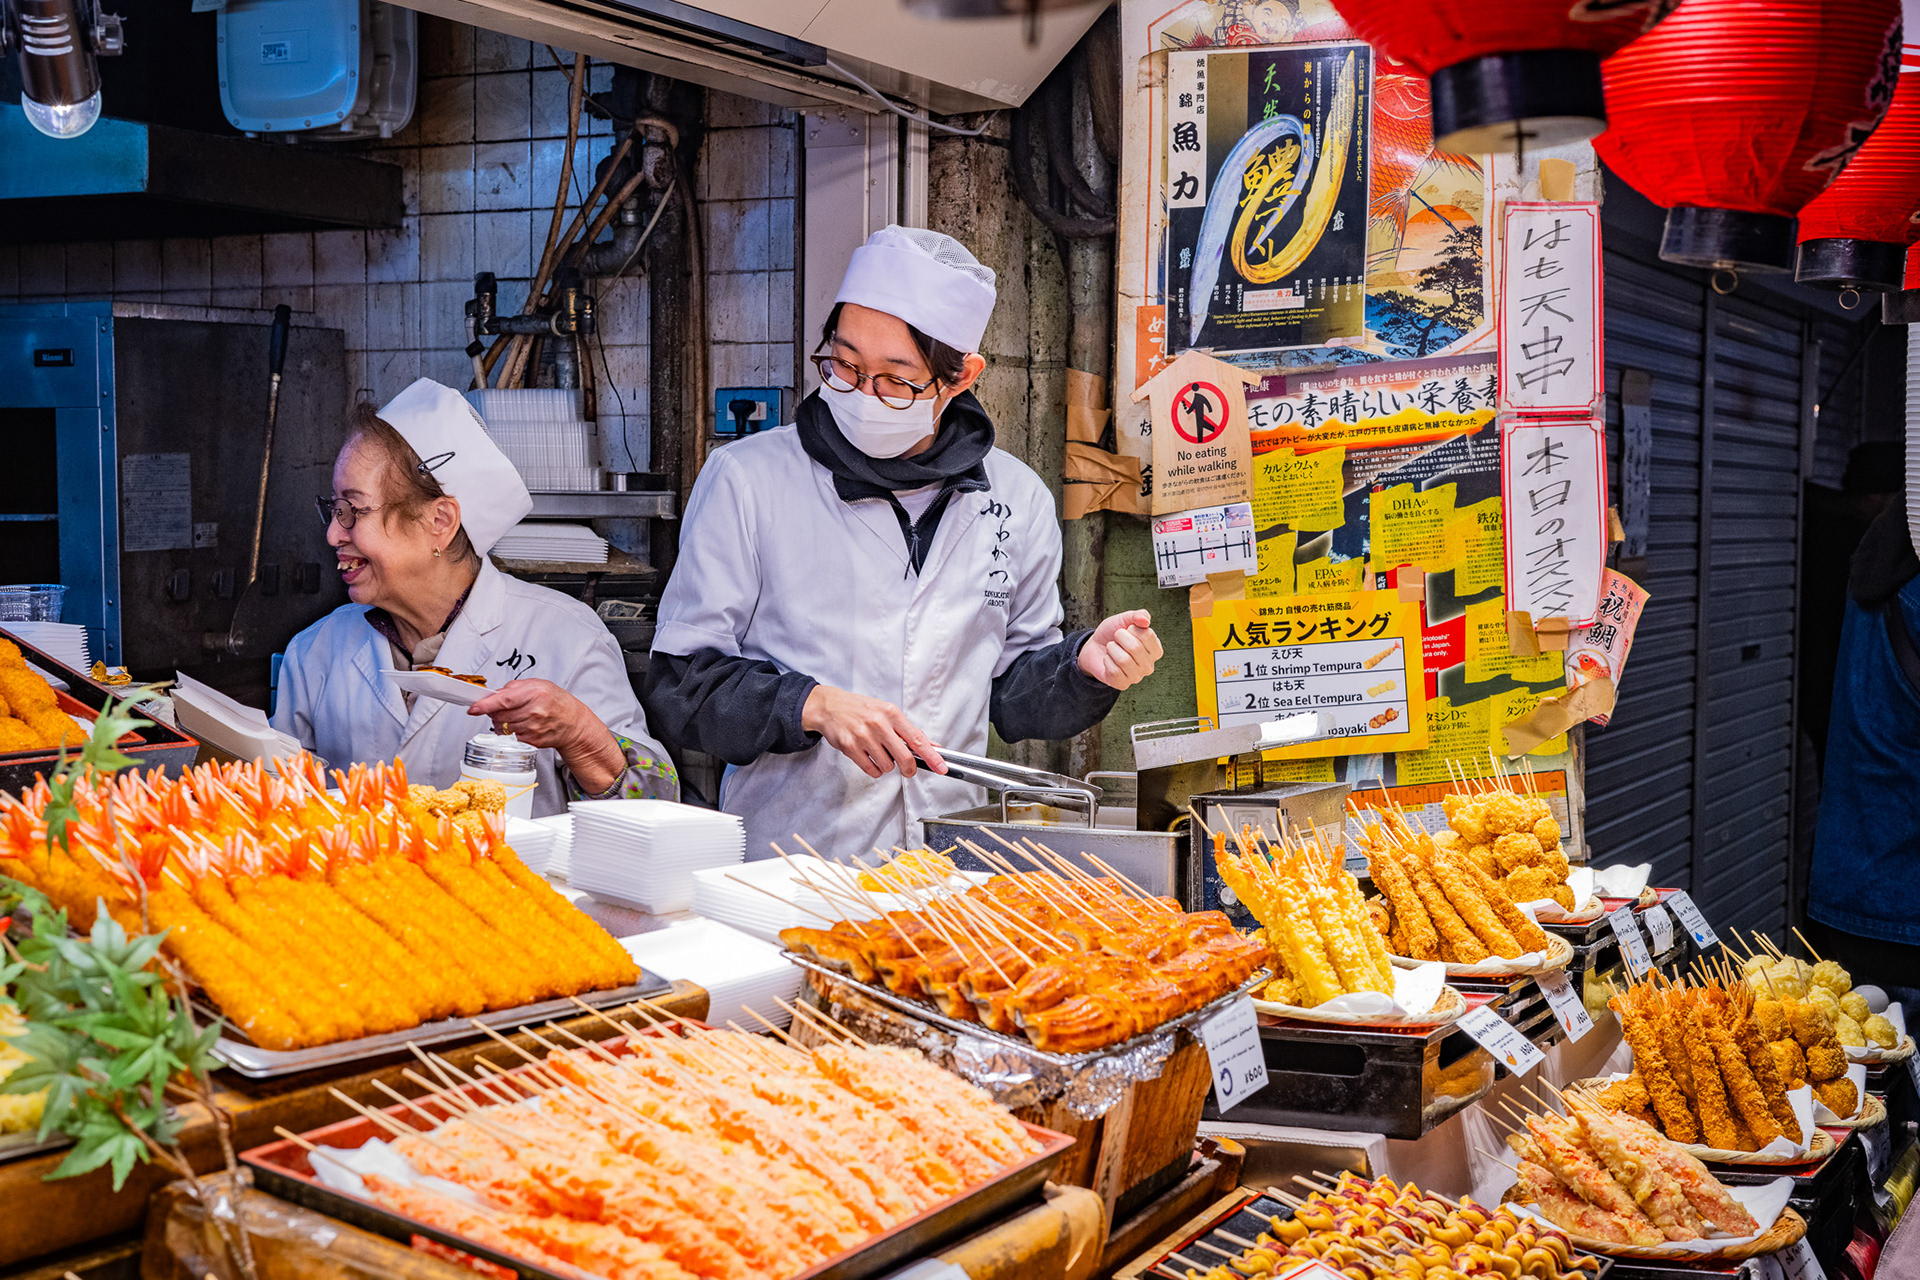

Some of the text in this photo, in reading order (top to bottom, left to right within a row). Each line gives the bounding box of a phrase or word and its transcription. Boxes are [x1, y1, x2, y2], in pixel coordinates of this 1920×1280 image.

[1196, 58, 1205, 115] 焼魚専門店
[1262, 63, 1281, 130] 天然
[1177, 446, 1227, 462] No eating
[1168, 459, 1237, 478] while walking
[1258, 601, 1351, 616] 錦魚力 自慢の売れ筋商品
[1586, 590, 1625, 651] 祝鯛
[1222, 611, 1392, 648] 人気ランキング
[1271, 647, 1303, 660] えび天
[1271, 664, 1311, 675] Shrimp
[1312, 661, 1362, 673] Tempura
[1273, 679, 1305, 692] はも天
[1273, 697, 1293, 707] Sea
[1295, 695, 1311, 705] Eel
[1313, 693, 1363, 705] Tempura
